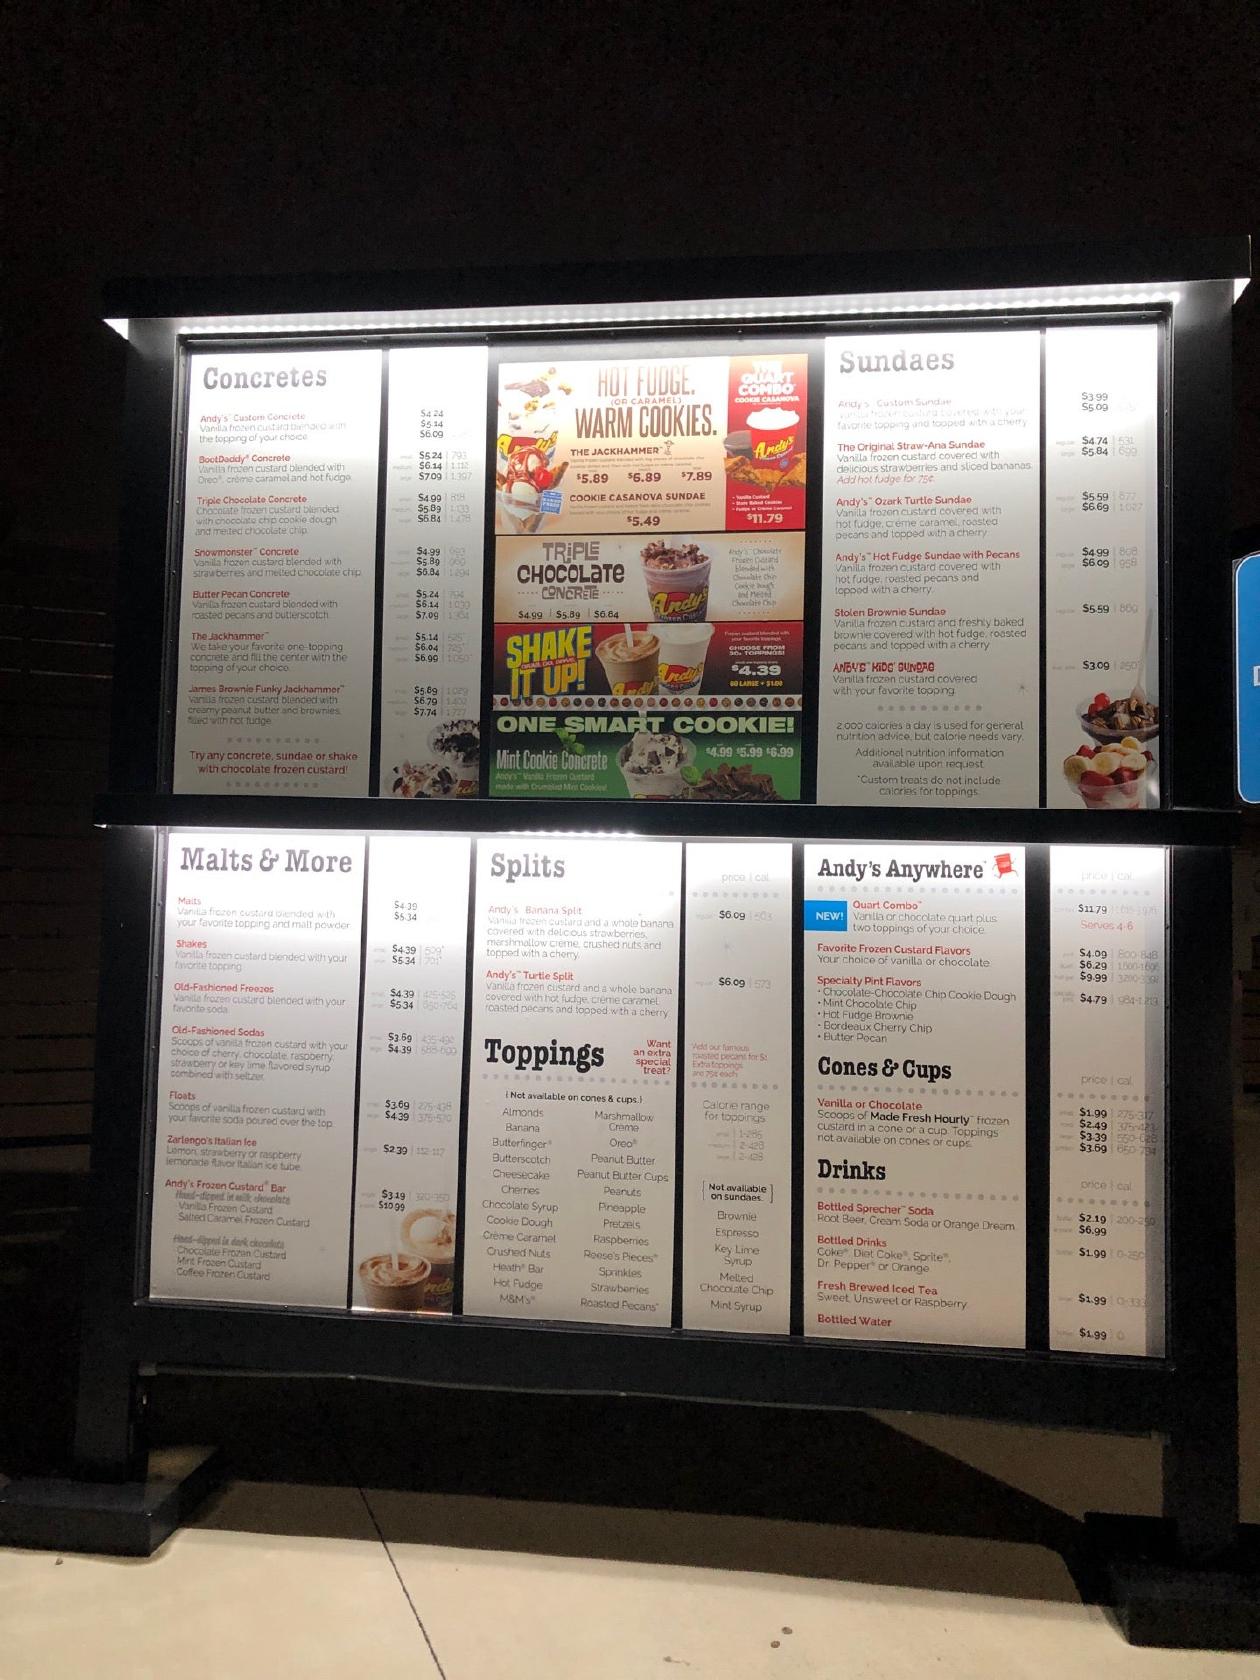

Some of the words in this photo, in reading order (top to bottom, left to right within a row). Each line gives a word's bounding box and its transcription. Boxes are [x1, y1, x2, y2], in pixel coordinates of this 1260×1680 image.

[840, 350, 954, 373] Sundaes
[203, 367, 327, 390] Concretes
[598, 368, 631, 397] HOT
[636, 365, 695, 396] FUDGE.
[631, 397, 681, 405] CARAMEL)
[576, 406, 632, 438] WARM
[640, 404, 717, 437] COOKIES.
[1082, 436, 1108, 446] $4.74
[571, 448, 589, 456] THE
[838, 443, 855, 452] The
[858, 442, 894, 453] Original
[897, 442, 946, 451] Straw-Ana
[949, 441, 985, 449] Sundae
[1082, 447, 1108, 456] $5.84
[420, 451, 442, 460] $5.24
[837, 453, 868, 462] Vanilla
[871, 453, 899, 461] frozen
[902, 452, 935, 461] custard
[939, 452, 977, 460] covered
[980, 451, 1000, 459] with
[419, 462, 442, 470] $6.14
[577, 473, 608, 484] $5.89
[628, 472, 661, 483] $6.89
[682, 471, 712, 481] $7.89
[198, 496, 220, 504] Triple
[223, 496, 266, 504] Chocolate
[269, 495, 307, 504] Concrete
[418, 494, 441, 502] $4.99
[570, 494, 606, 502] COOKIE
[609, 493, 663, 502] CASANOVA
[666, 492, 705, 500] SUNDAE
[875, 497, 902, 505] Ozark
[905, 496, 933, 505] Turtle
[935, 495, 972, 504] Sundae
[1082, 491, 1108, 501] $5.59
[627, 516, 660, 527] $5.49
[747, 514, 783, 524] $11.79
[193, 590, 219, 598] Butter
[221, 590, 247, 598] Pecan
[250, 590, 289, 598] Concrete
[417, 590, 438, 599] $5.24
[416, 600, 438, 609] $6.14
[1082, 604, 1109, 614] $5.59
[519, 610, 542, 619] $4.99
[556, 610, 580, 619] $5.89
[835, 608, 865, 617] Stolen
[868, 608, 906, 617] Brownie
[909, 607, 946, 616] Sundae
[416, 633, 438, 642] $5.14
[507, 626, 592, 669] SHAKE
[415, 653, 438, 662] $6.99
[732, 664, 781, 676] $4.39
[1082, 660, 1110, 670] $3.09
[511, 667, 535, 700] IT
[542, 658, 584, 696] UP!
[414, 697, 437, 706] $6.79
[414, 708, 436, 717] $7.74
[497, 716, 555, 733] ONE
[563, 716, 664, 733] SMART
[673, 716, 794, 733] COOKIE!
[190, 751, 204, 761] Try
[207, 753, 224, 762] any
[227, 751, 273, 761] concrete,
[277, 752, 313, 760] sundae
[330, 751, 357, 761] shake
[706, 747, 732, 758] $4.99
[736, 747, 762, 757] $5.99
[767, 747, 793, 758] $6.99
[855, 749, 904, 757] Additional
[906, 749, 946, 757] nutrition
[949, 749, 1004, 757] information
[496, 750, 519, 770] Mint
[523, 750, 558, 770] Cookie
[562, 750, 607, 770] Concrete
[199, 765, 219, 774] with
[221, 765, 270, 774] chocolate
[273, 765, 304, 775] frozen
[307, 765, 348, 775] custard!
[180, 847, 252, 871] Malts
[260, 849, 279, 871] &
[285, 850, 352, 872] More
[491, 853, 565, 883] Splits
[818, 859, 881, 881] Andy's
[1078, 904, 1107, 913] $11.79
[816, 912, 843, 921] NEW!
[177, 940, 207, 948] Shakes
[393, 945, 416, 954] $4.39
[818, 943, 857, 953] Favorite
[859, 945, 892, 954] Frozen
[894, 945, 932, 955] Custard
[935, 946, 971, 956] Flavors
[393, 956, 415, 965] $5.34
[823, 1011, 840, 1019] Hot
[843, 1011, 872, 1022] Fudge
[875, 1011, 913, 1021] Brownie
[172, 1026, 235, 1035] Old-Fashioned
[238, 1027, 264, 1037] Sodas
[647, 1040, 671, 1048] Want
[485, 1039, 604, 1073] Toppings
[648, 1049, 671, 1057] extra
[636, 1057, 671, 1067] special
[643, 1066, 670, 1075] treat?
[818, 1057, 877, 1076] Cones
[882, 1058, 900, 1077] &
[903, 1060, 951, 1082] Cups
[528, 1092, 564, 1101] available
[581, 1094, 605, 1102] cones
[608, 1095, 614, 1103] &
[818, 1098, 853, 1108] Vanilla
[856, 1101, 866, 1109] or
[869, 1100, 922, 1111] Chocolate
[502, 1108, 543, 1117] Almonds
[595, 1111, 653, 1121] Marshmallow
[1079, 1108, 1107, 1118] $1.99
[1080, 1120, 1107, 1130] $2.49
[384, 1145, 407, 1155] $2.39
[492, 1154, 550, 1163] Butterscotch
[818, 1159, 886, 1180] Drinks
[577, 1170, 610, 1180] Peanut
[613, 1171, 641, 1181] Butter
[644, 1173, 668, 1183] Cups
[726, 1185, 766, 1193] available
[382, 1190, 405, 1200] $3.19
[379, 1201, 405, 1211] $10.99
[599, 1203, 645, 1214] Pineapple
[718, 1211, 756, 1221] Brownie
[715, 1228, 759, 1238] Espresso
[818, 1281, 846, 1290] Fresh
[849, 1282, 889, 1292] Brewed
[892, 1284, 914, 1293] Iced
[918, 1286, 937, 1295] Tea
[818, 1314, 856, 1325] Bottled
[859, 1317, 892, 1327] Water
